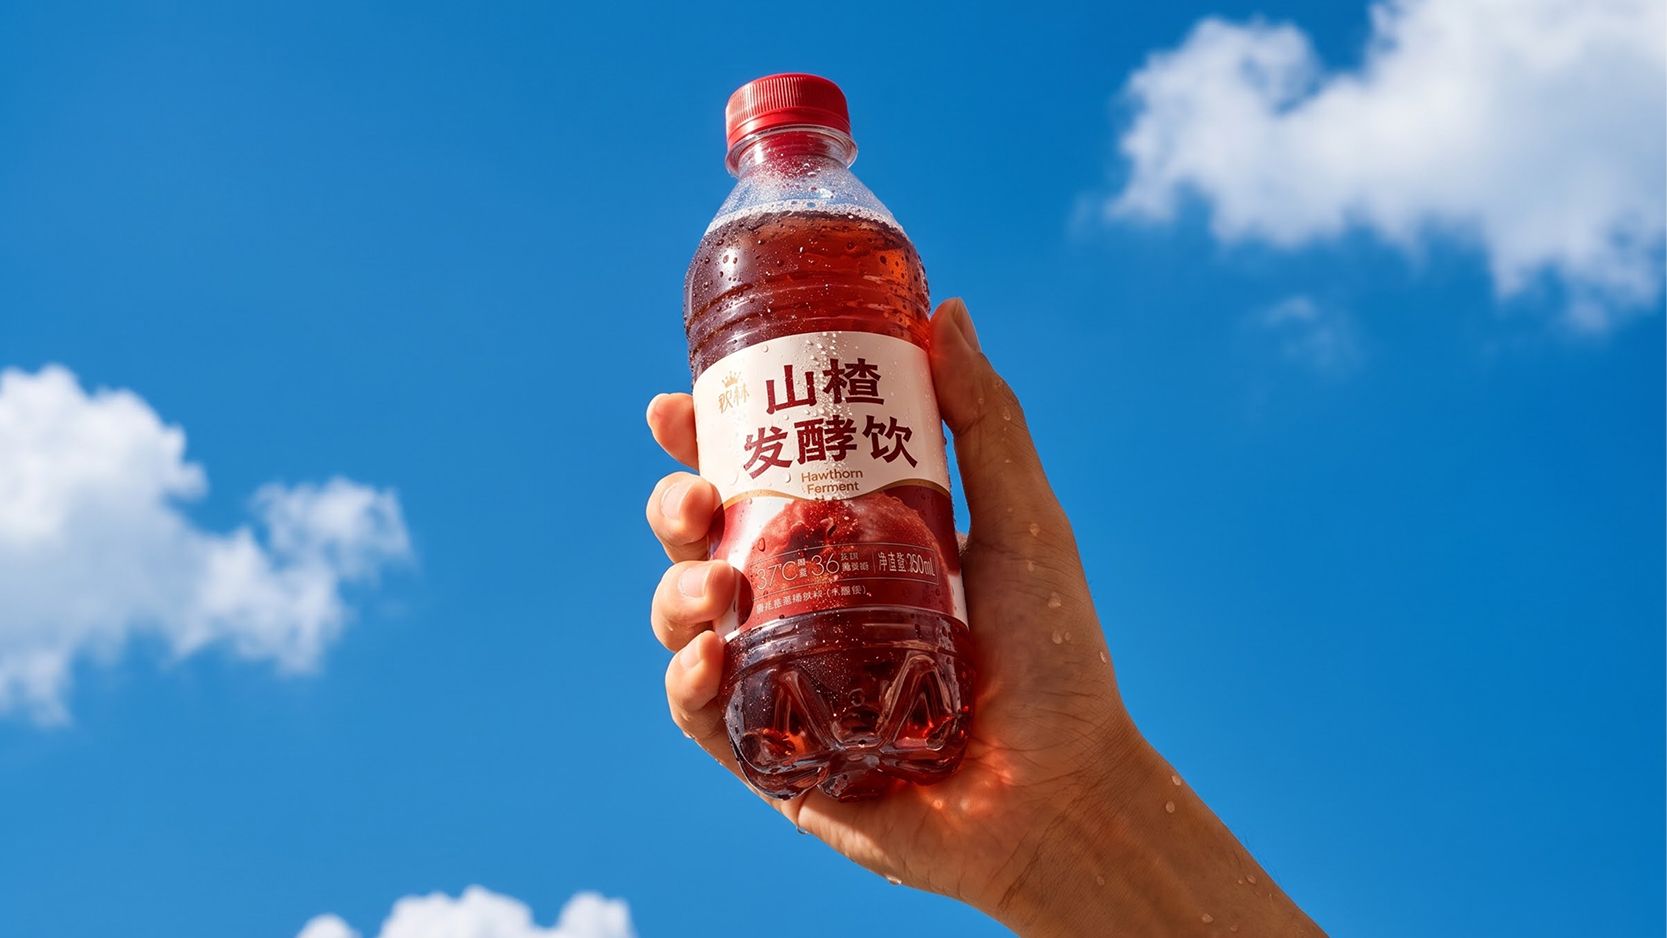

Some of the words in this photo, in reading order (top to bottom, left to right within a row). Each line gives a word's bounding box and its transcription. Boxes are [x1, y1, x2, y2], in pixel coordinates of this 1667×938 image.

[766, 358, 884, 415] 山楂
[743, 414, 918, 480] 发酵饮
[801, 468, 863, 482] Hawthorn
[807, 482, 860, 494] Ferment
[810, 553, 840, 576] 36
